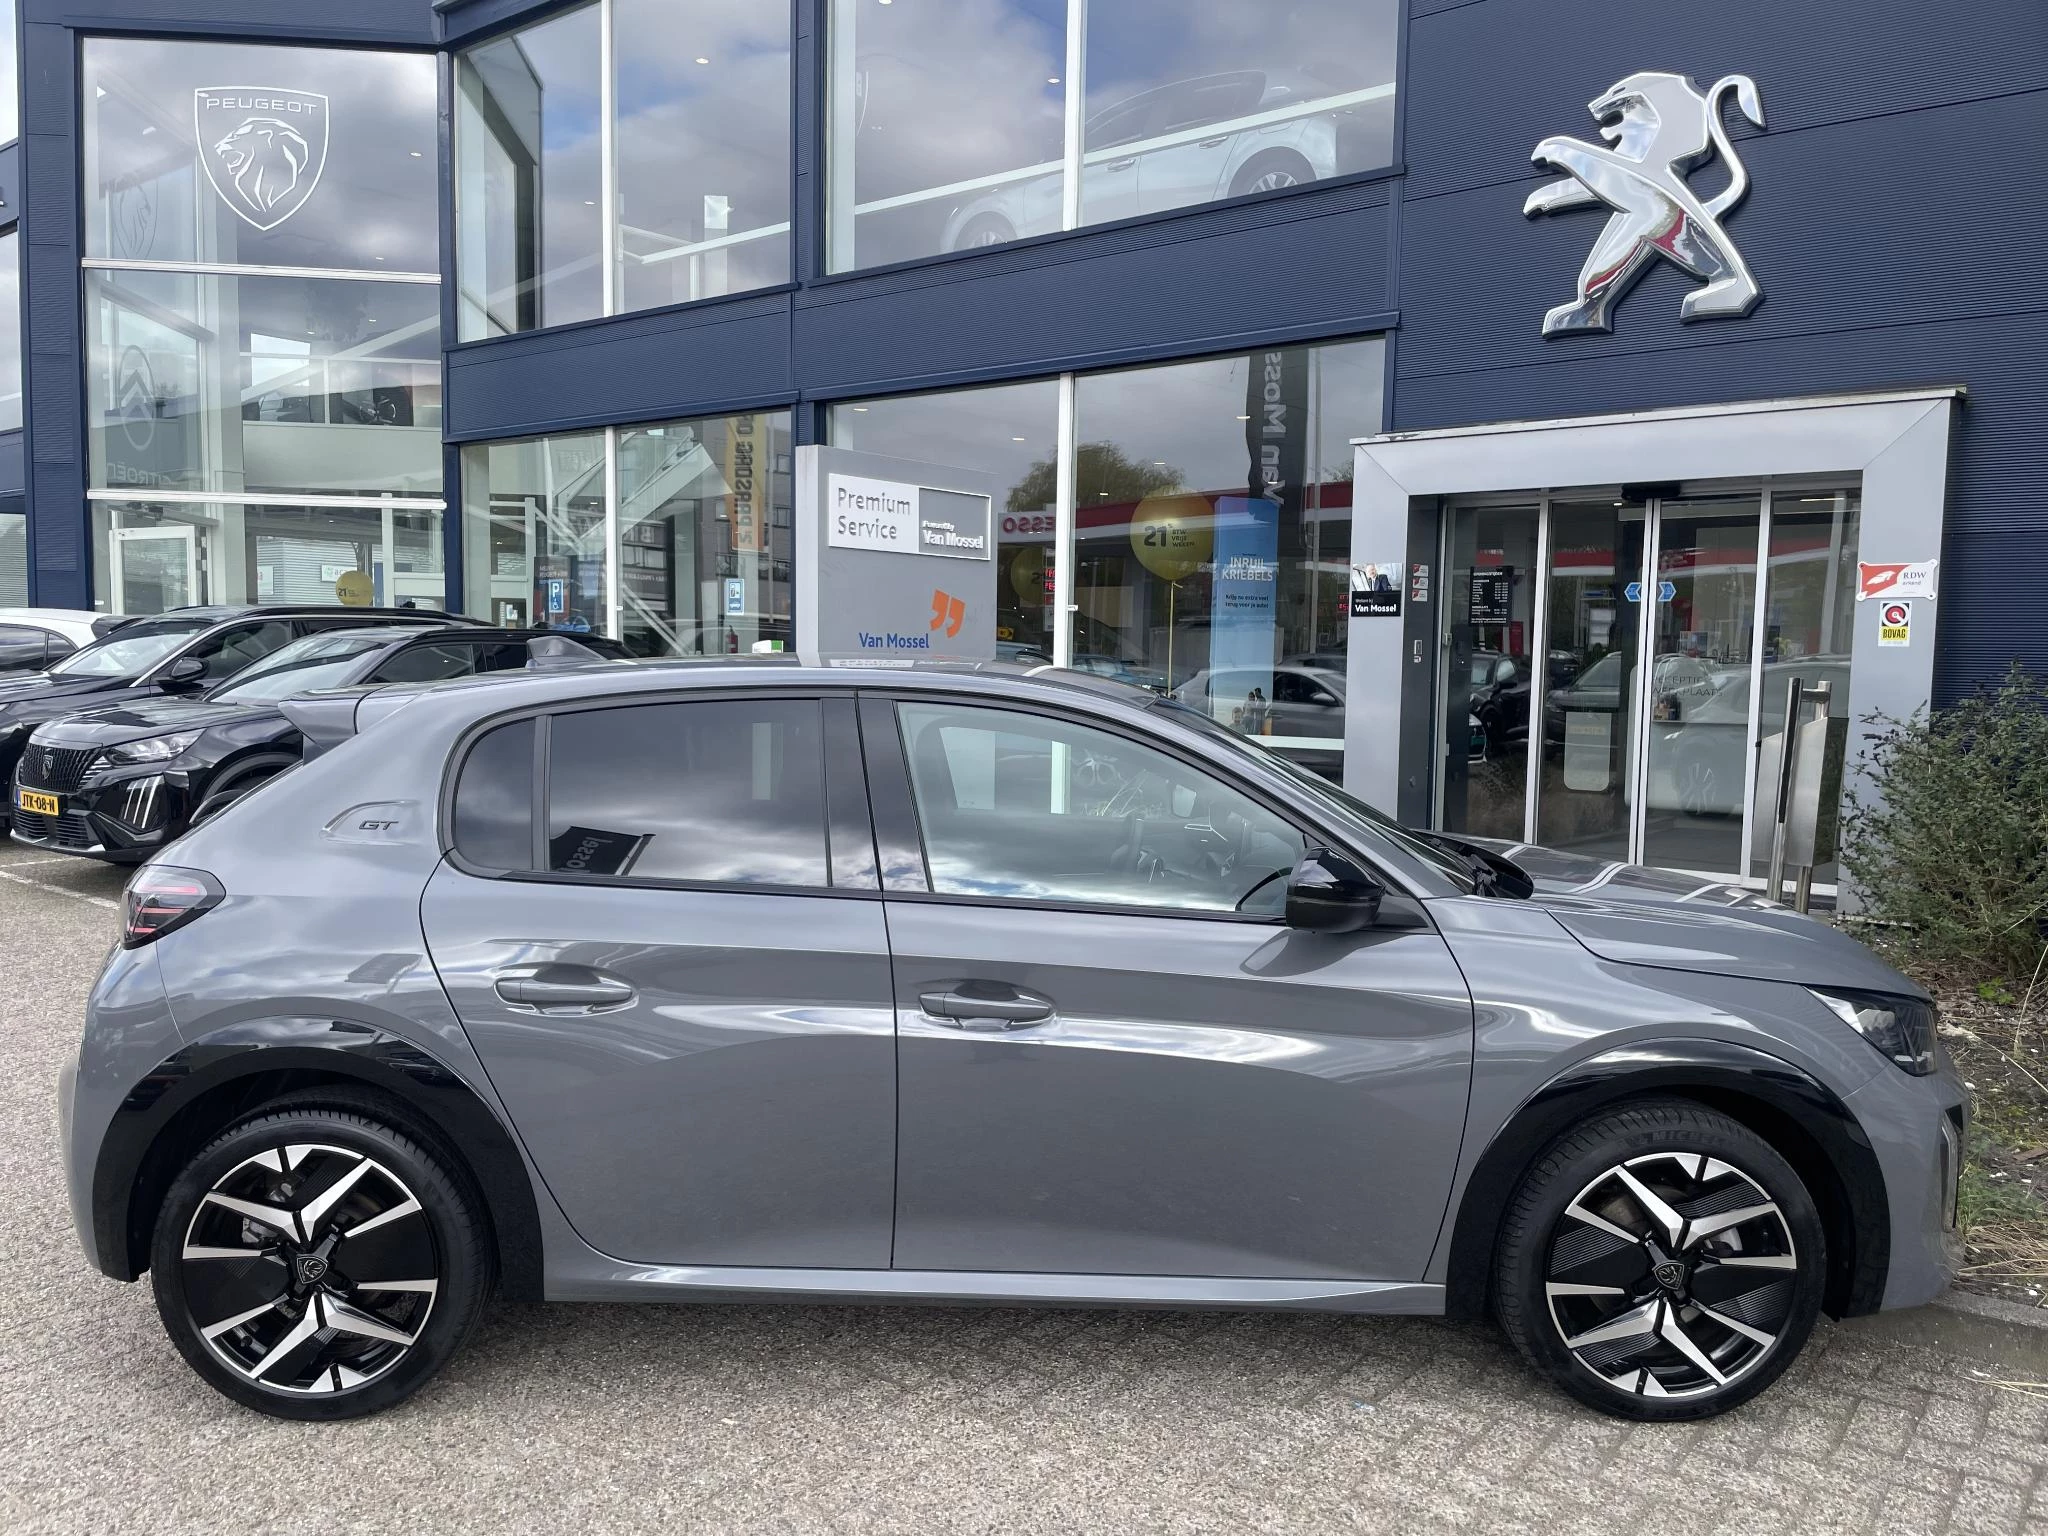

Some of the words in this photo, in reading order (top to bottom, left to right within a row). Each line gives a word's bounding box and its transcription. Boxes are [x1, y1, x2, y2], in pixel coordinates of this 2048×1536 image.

[206, 97, 317, 115] PEUGEOT
[838, 487, 911, 515] Premium
[838, 515, 897, 540] Service
[923, 530, 945, 545] Van
[946, 532, 984, 549] Mossel
[1230, 556, 1267, 569] INRUIL
[1222, 569, 1273, 581] KRIEBELS
[552, 583, 560, 598] P
[1355, 604, 1369, 612] Van
[1370, 604, 1397, 612] Mossel
[859, 632, 883, 648] Van
[886, 633, 930, 649] Mossel
[1882, 628, 1906, 639] BOVAG
[22, 793, 55, 812] JTK-08-N
[359, 820, 399, 830] GT
